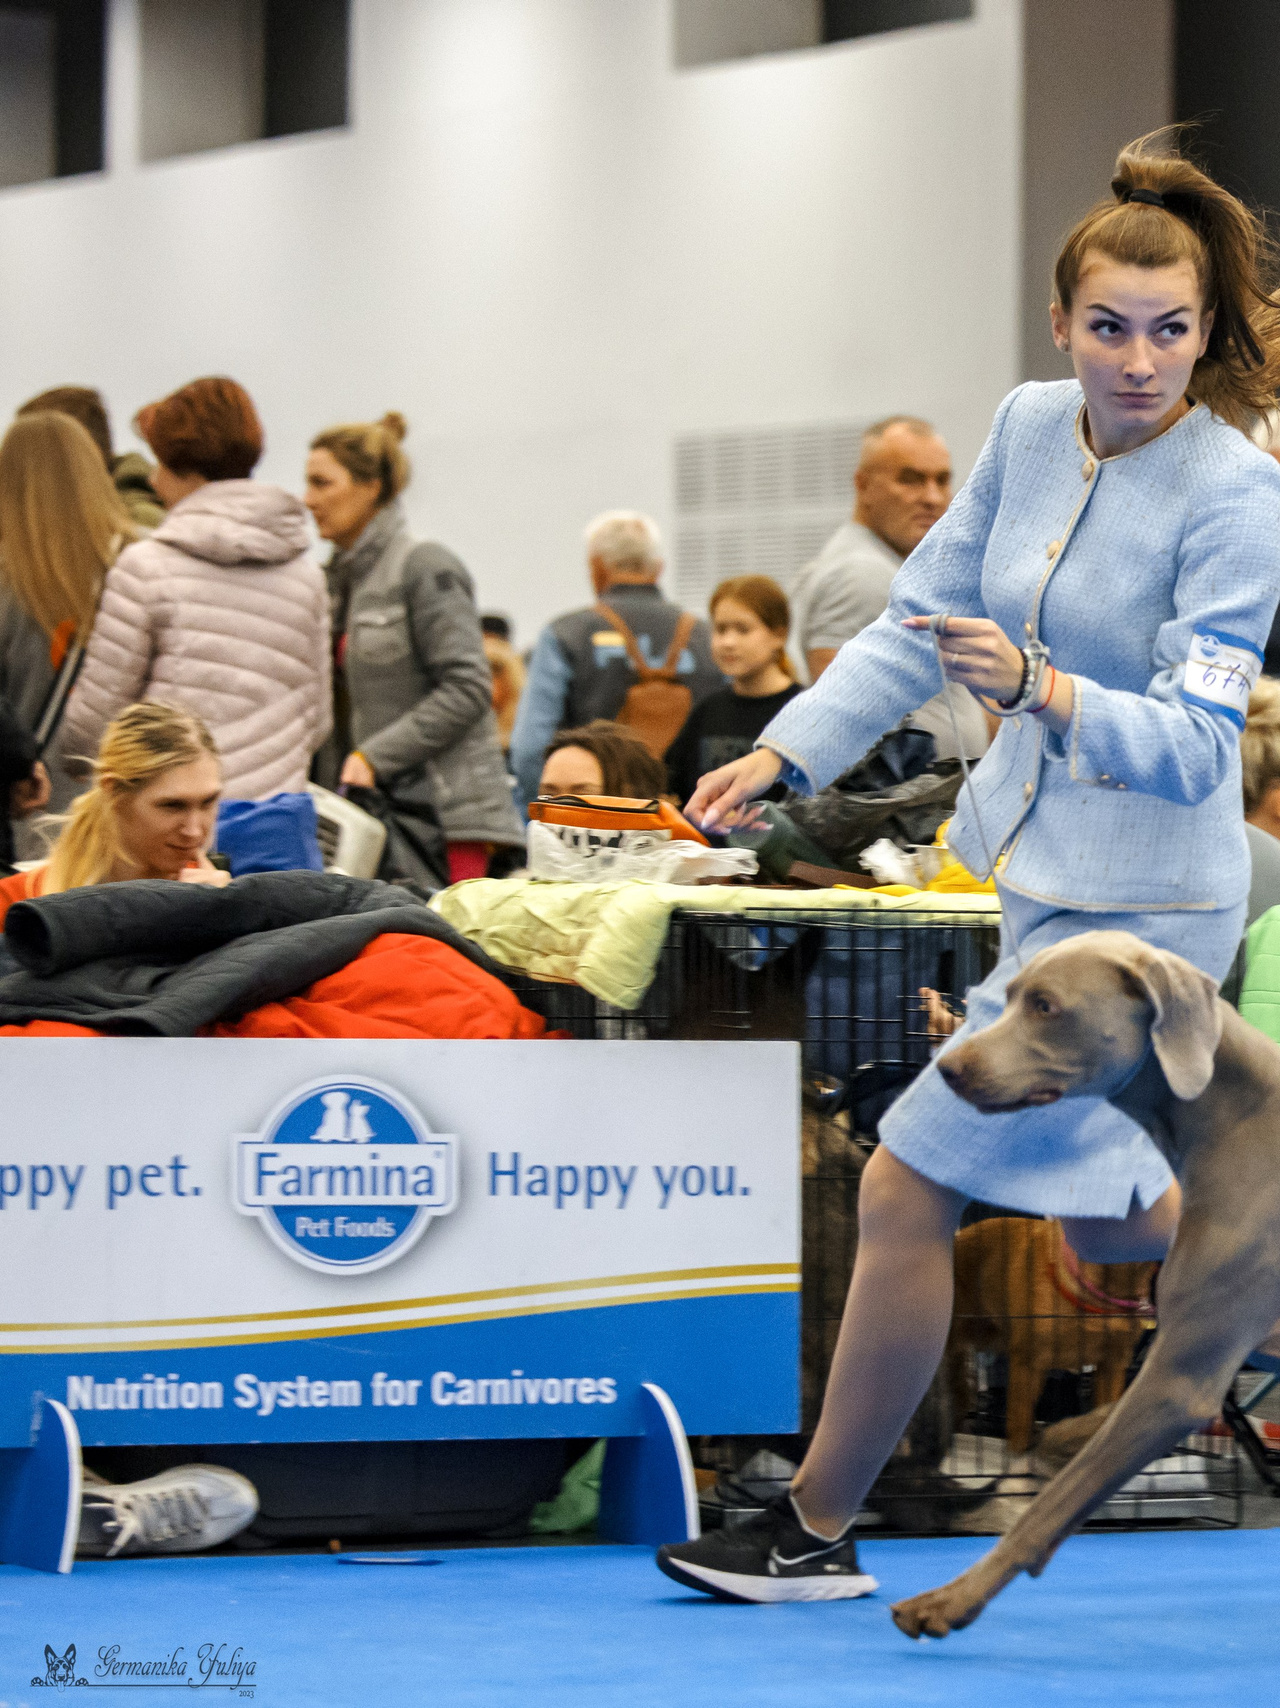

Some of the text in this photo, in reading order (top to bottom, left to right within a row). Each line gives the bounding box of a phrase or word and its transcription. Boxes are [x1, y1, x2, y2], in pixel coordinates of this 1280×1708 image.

[106, 1154, 203, 1211] pet.
[255, 1151, 436, 1197] Farmina
[487, 1151, 752, 1210] Happy you.
[294, 1215, 397, 1238] Pet Foods
[66, 1369, 618, 1417] Nutrition System for Carnivores
